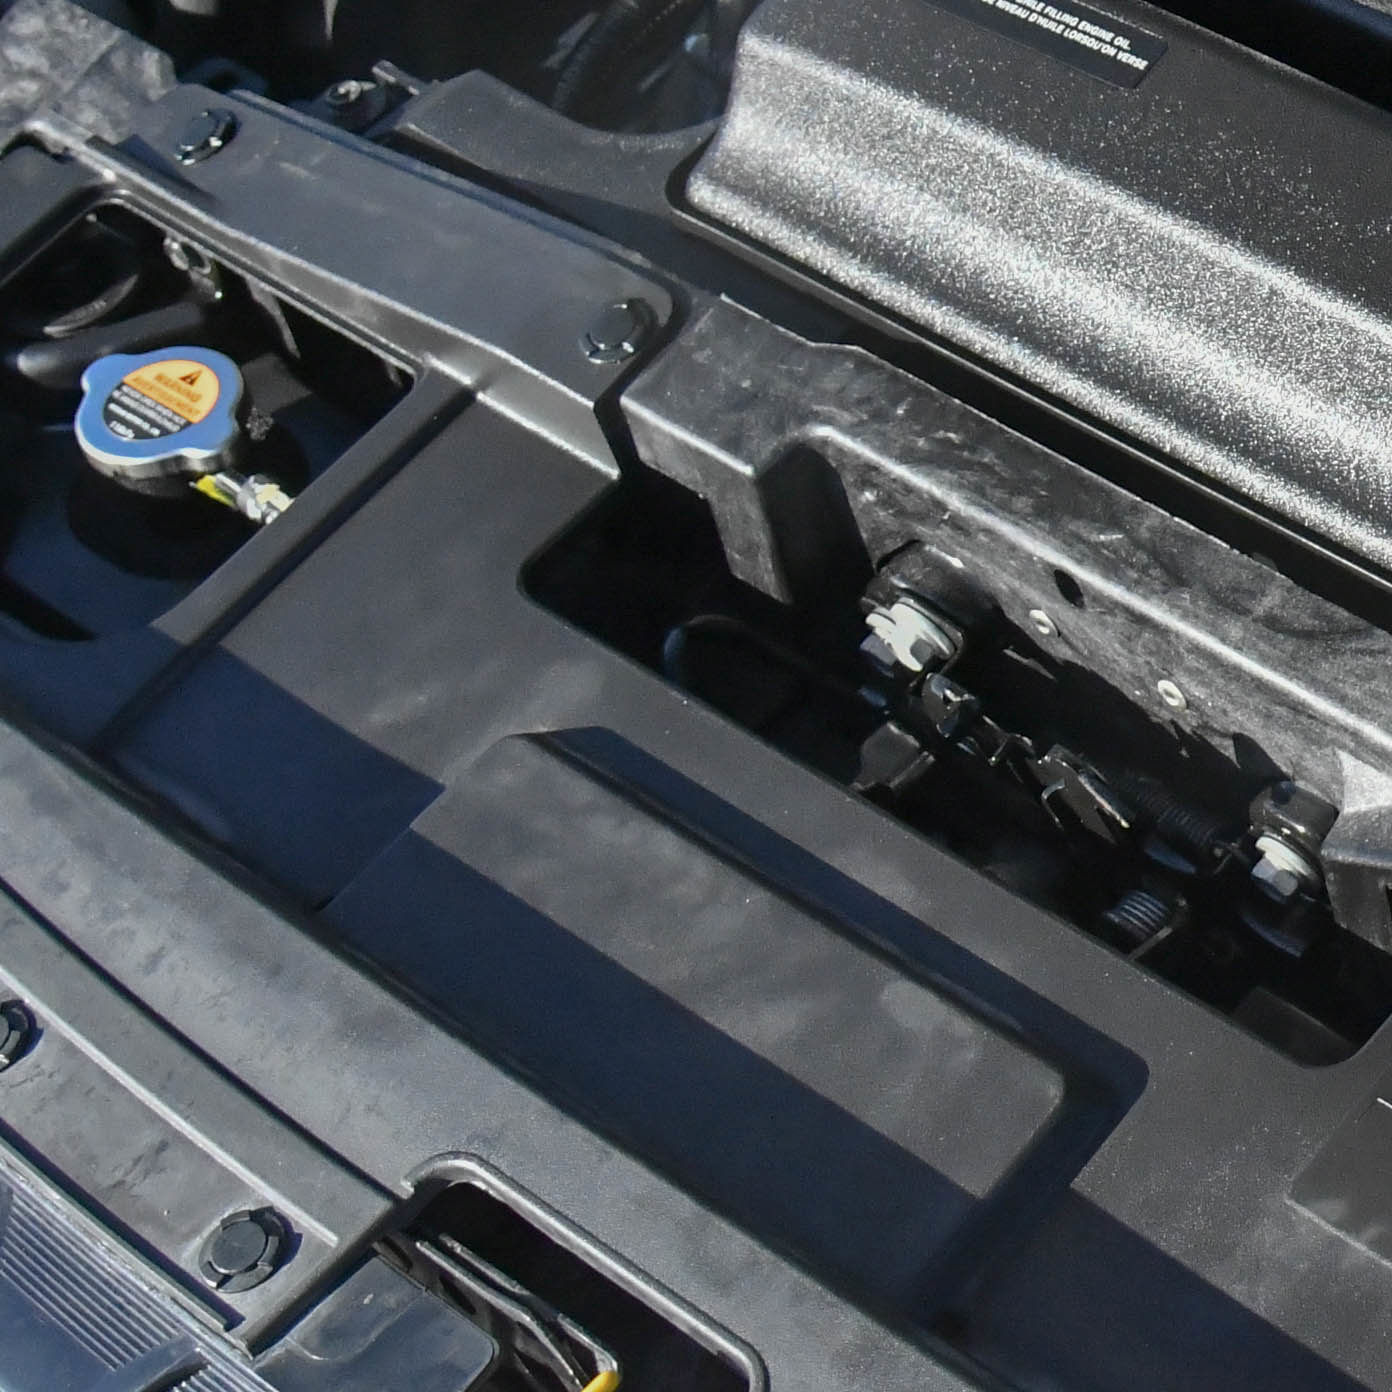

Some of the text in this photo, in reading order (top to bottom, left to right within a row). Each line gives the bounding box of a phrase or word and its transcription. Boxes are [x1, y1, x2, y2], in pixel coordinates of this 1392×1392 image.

[1028, 12, 1065, 33] D'HUILE
[1063, 28, 1117, 56] LORSQU'ON
[1116, 50, 1147, 69] VERSE
[1043, 5, 1078, 26] FILLING
[1077, 20, 1114, 41] ENGINE
[1113, 36, 1130, 50] OIL.
